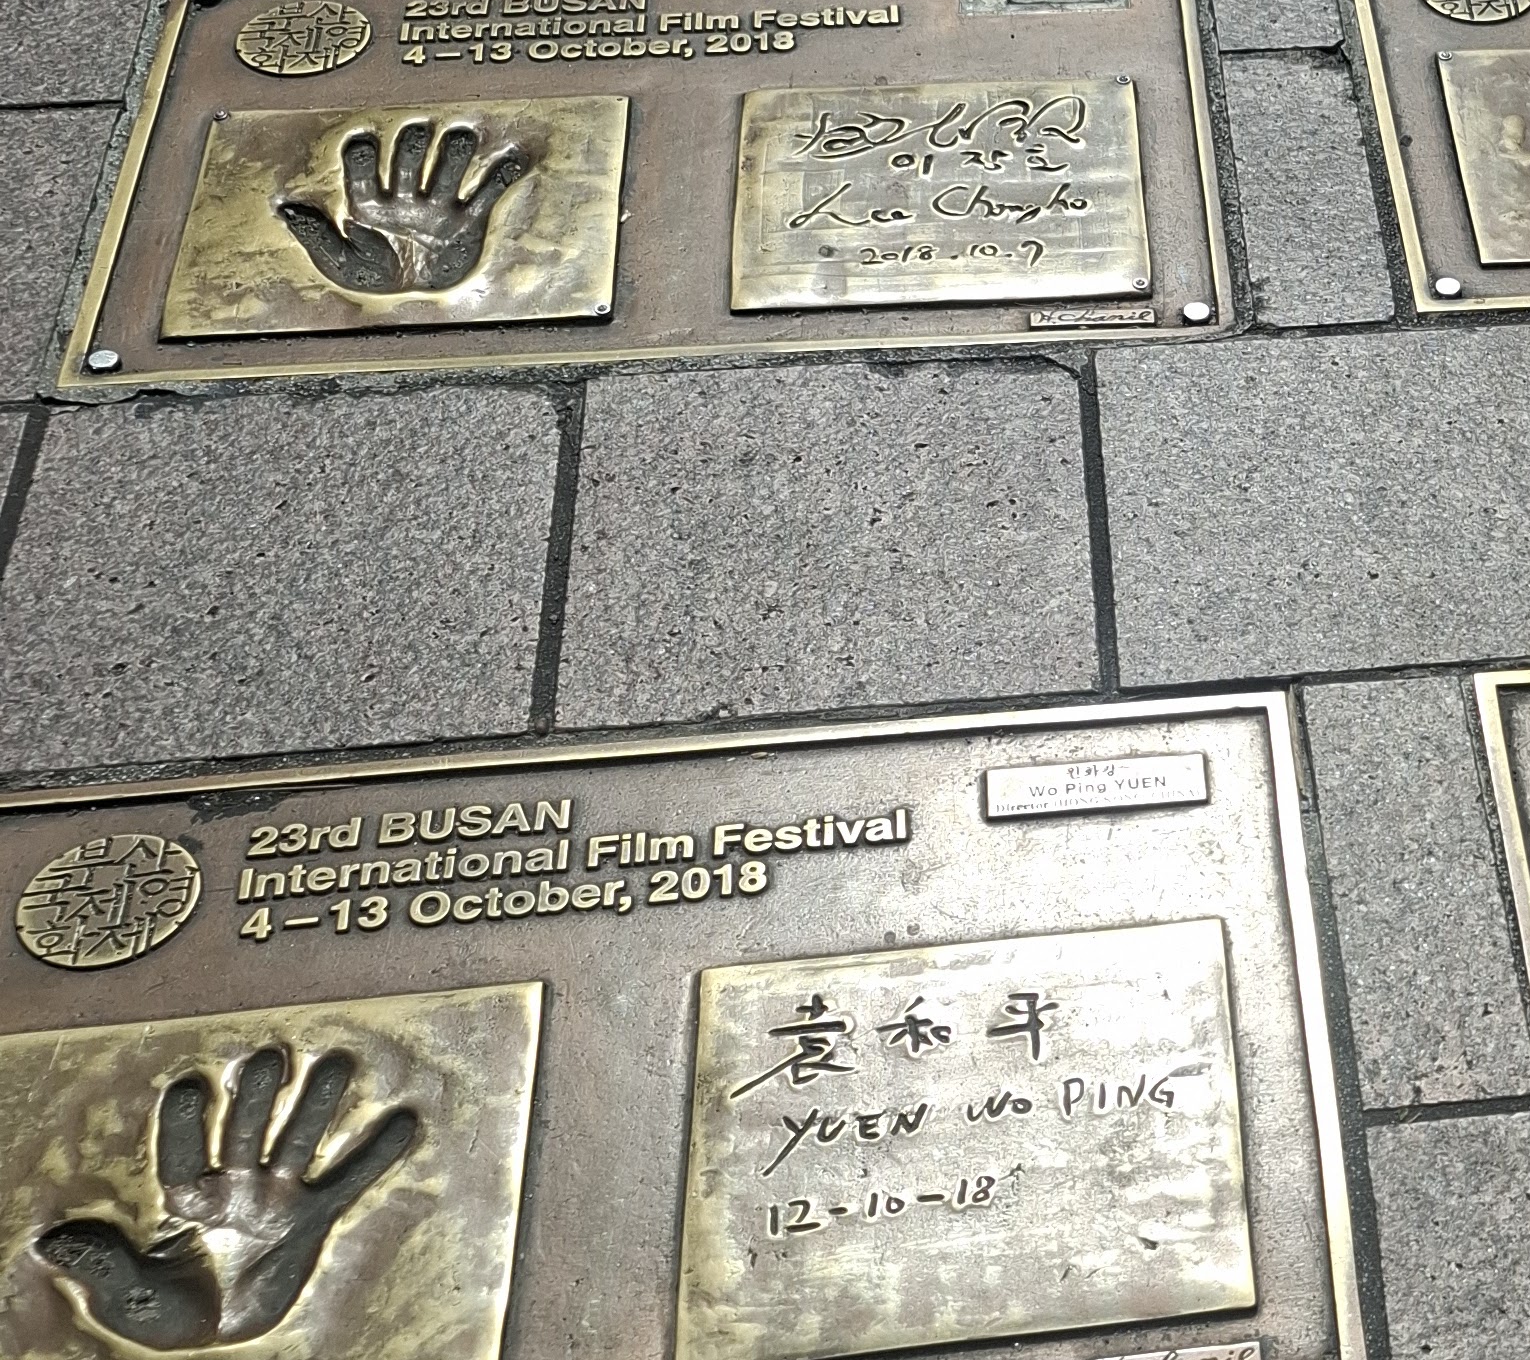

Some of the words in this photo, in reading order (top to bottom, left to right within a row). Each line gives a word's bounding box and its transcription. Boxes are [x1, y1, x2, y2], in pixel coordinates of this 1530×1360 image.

[399, 14, 647, 42] International
[658, 12, 740, 32] Film
[753, 4, 900, 29] Festival
[527, 37, 694, 60] October,
[705, 31, 796, 54] 2018
[1028, 785, 1058, 798] Wo
[1065, 781, 1107, 795] Ping
[1114, 775, 1168, 791] YUEN
[236, 838, 570, 903] International
[586, 832, 695, 870] Film
[712, 808, 909, 857] Festival
[246, 816, 363, 859] 23rd
[377, 799, 572, 845] BUSAN
[408, 880, 633, 927] October,
[647, 860, 769, 904] 2018
[762, 1102, 929, 1178] YUEN
[1061, 1072, 1176, 1117] PING
